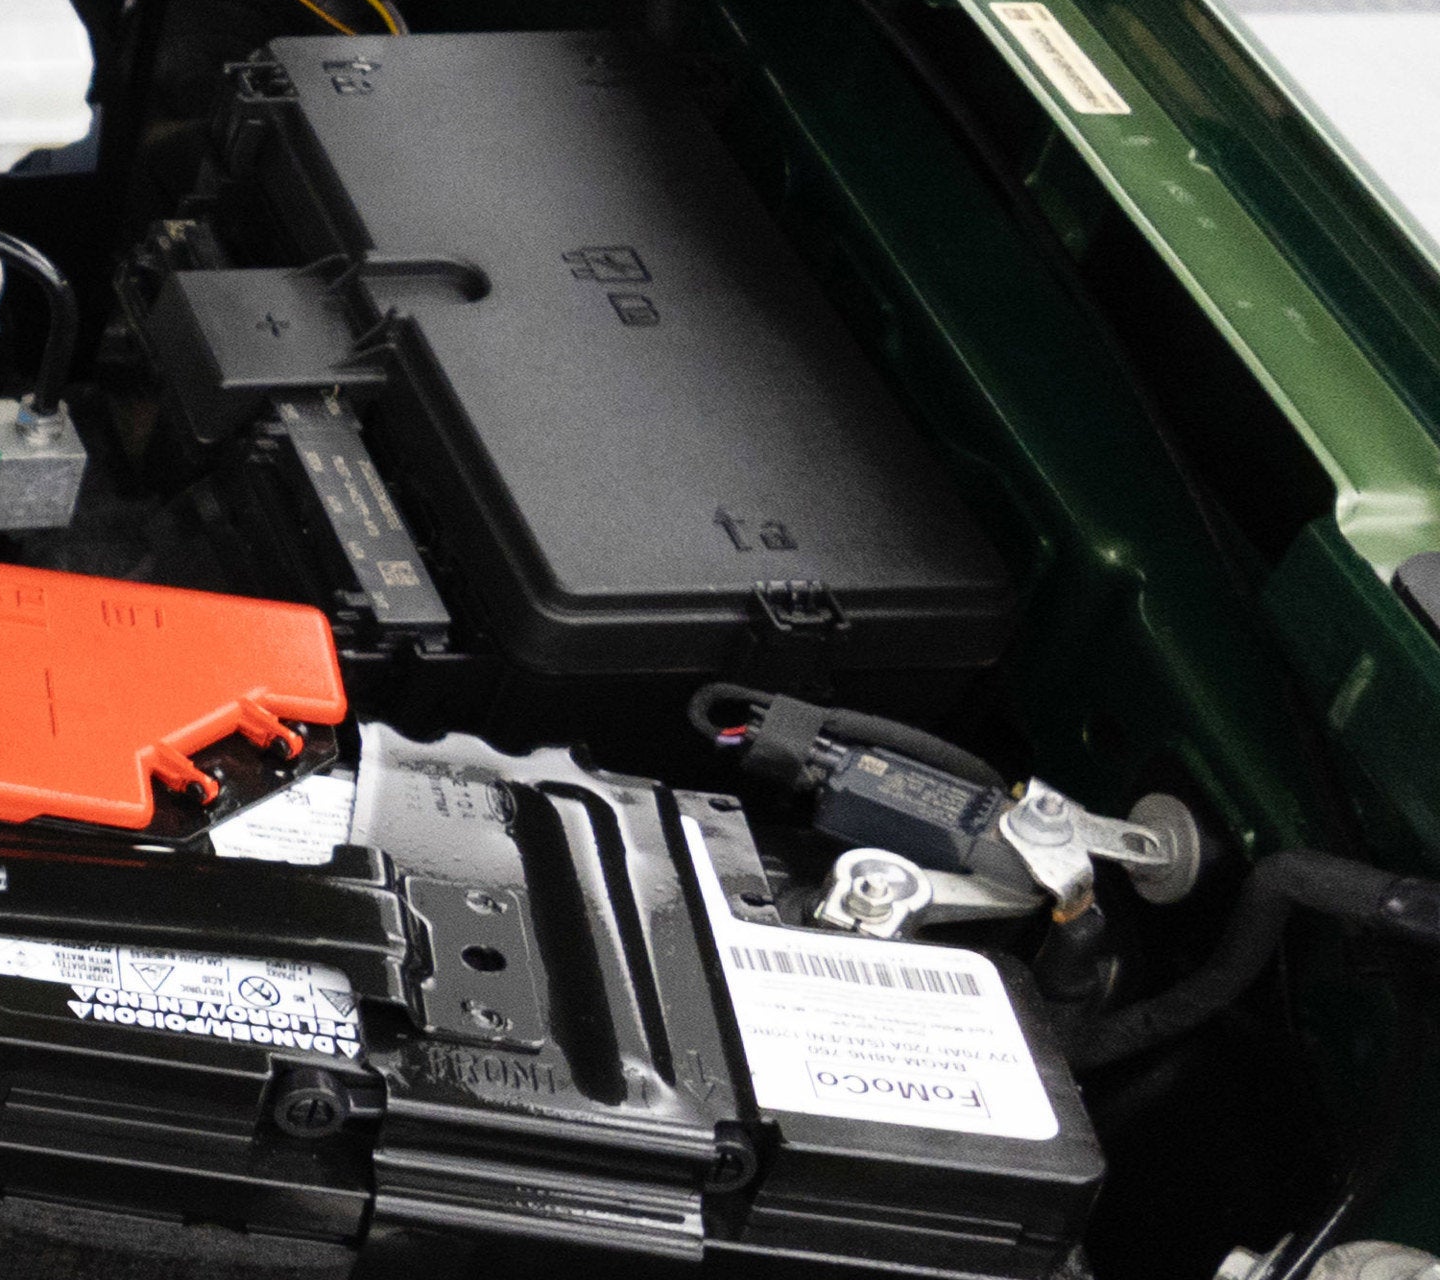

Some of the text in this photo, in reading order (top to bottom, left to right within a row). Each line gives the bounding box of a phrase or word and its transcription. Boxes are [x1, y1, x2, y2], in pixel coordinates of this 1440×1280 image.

[93, 999, 336, 1054] DANGER/POISON
[94, 985, 357, 1040] PELIGRO/VENENO
[817, 1071, 981, 1108] FoMoCo
